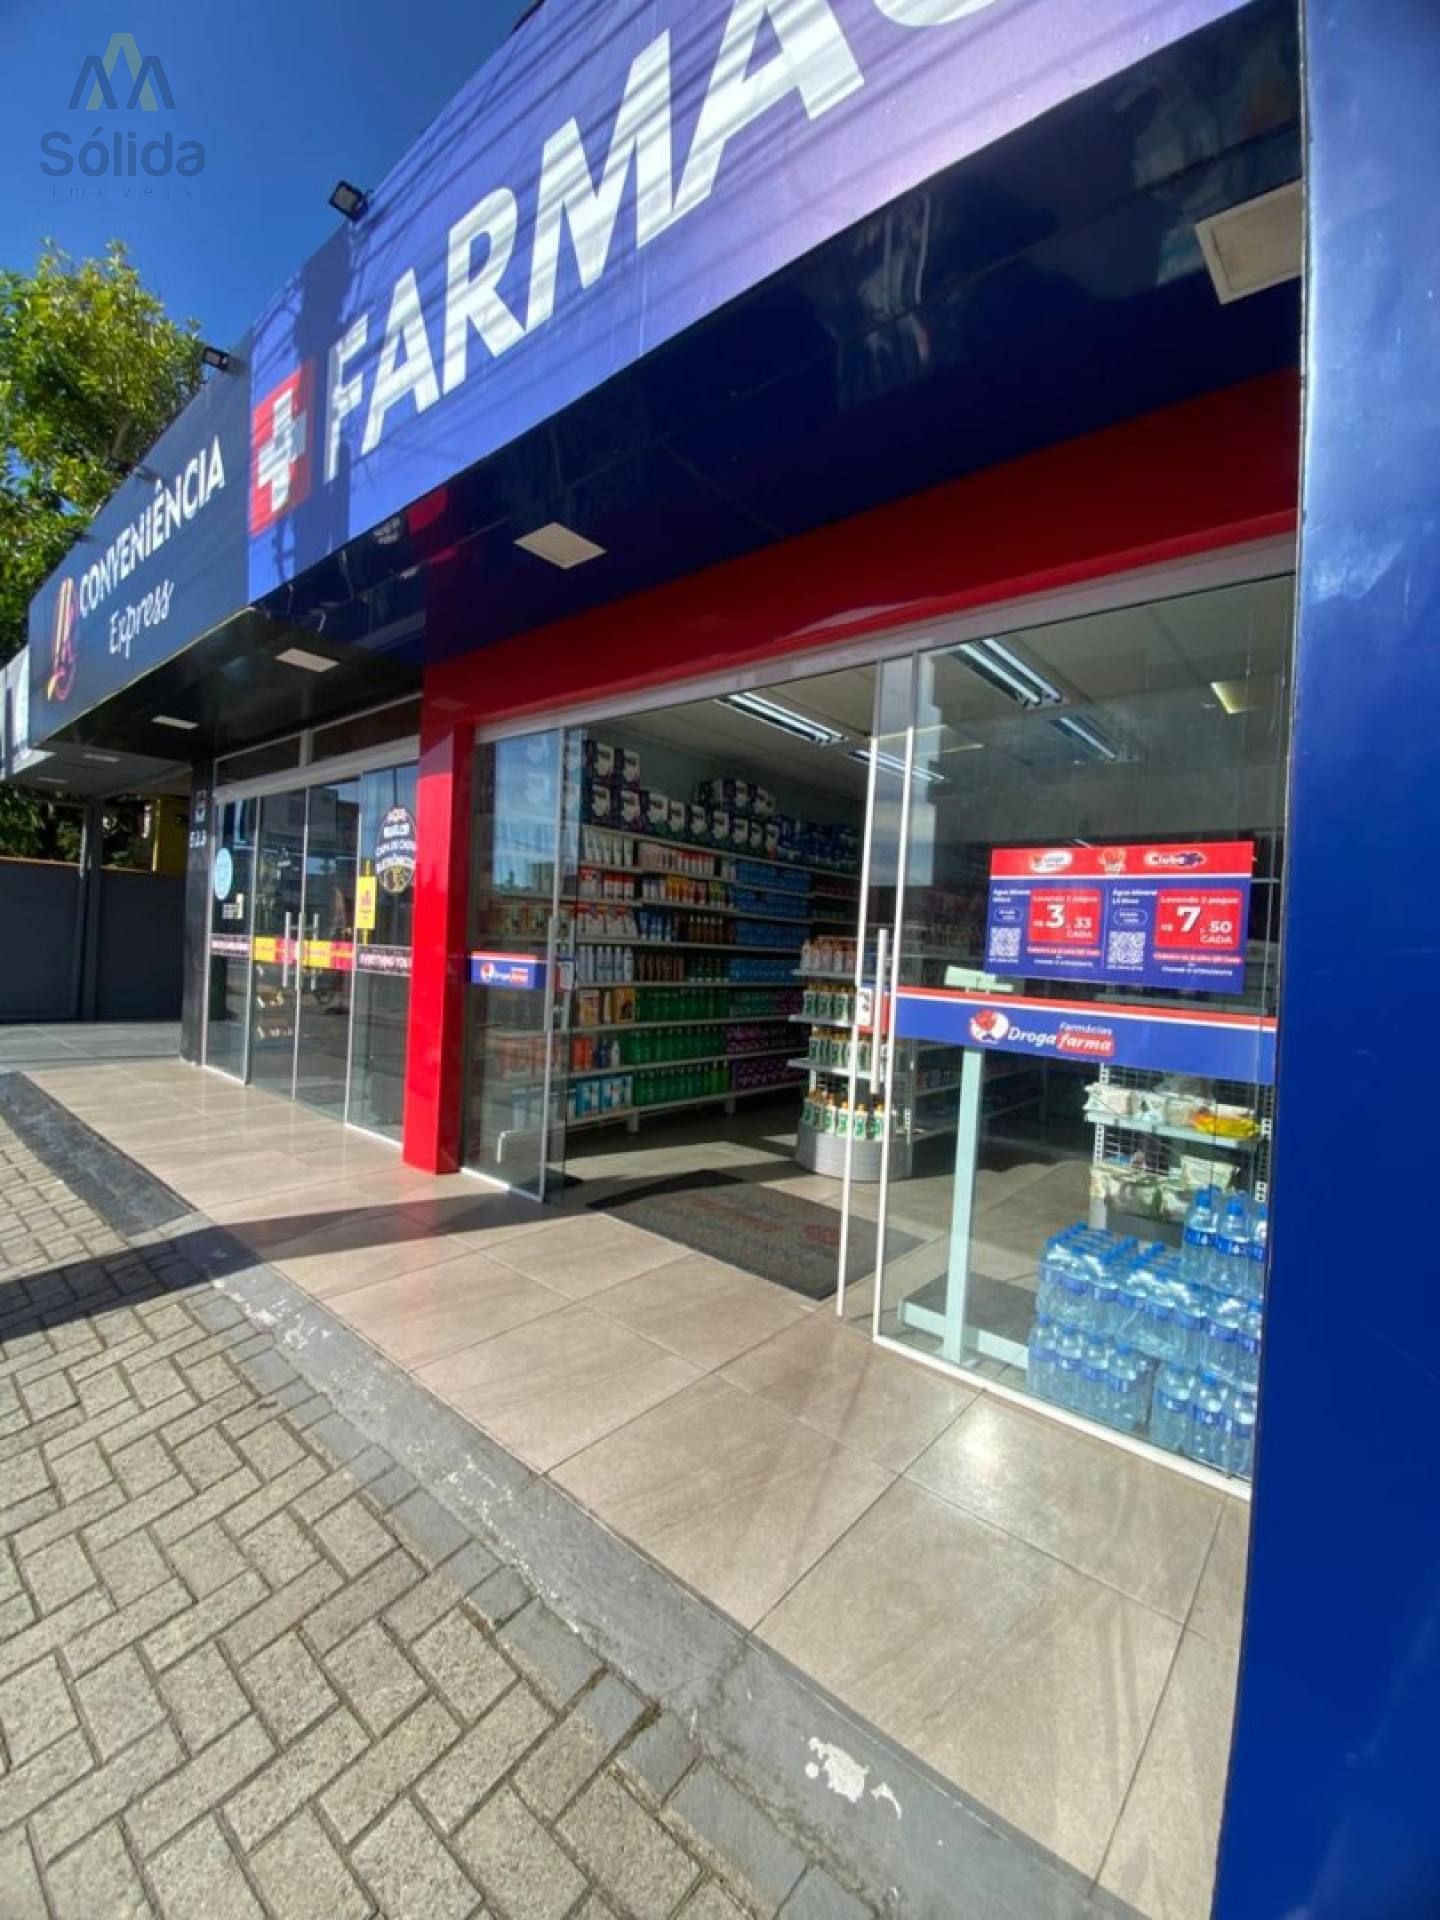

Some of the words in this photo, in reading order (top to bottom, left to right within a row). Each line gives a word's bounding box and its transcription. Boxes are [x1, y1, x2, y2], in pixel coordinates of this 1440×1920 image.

[323, 0, 998, 483] FARMA
[79, 433, 226, 619] CONVENIÊNCIA
[108, 578, 175, 660] Express
[1046, 904, 1065, 928] 3
[1177, 905, 1201, 932] 7
[1200, 934, 1233, 944] CADA
[1007, 1026, 1056, 1047] Droga
[1057, 1033, 1113, 1051] farma
